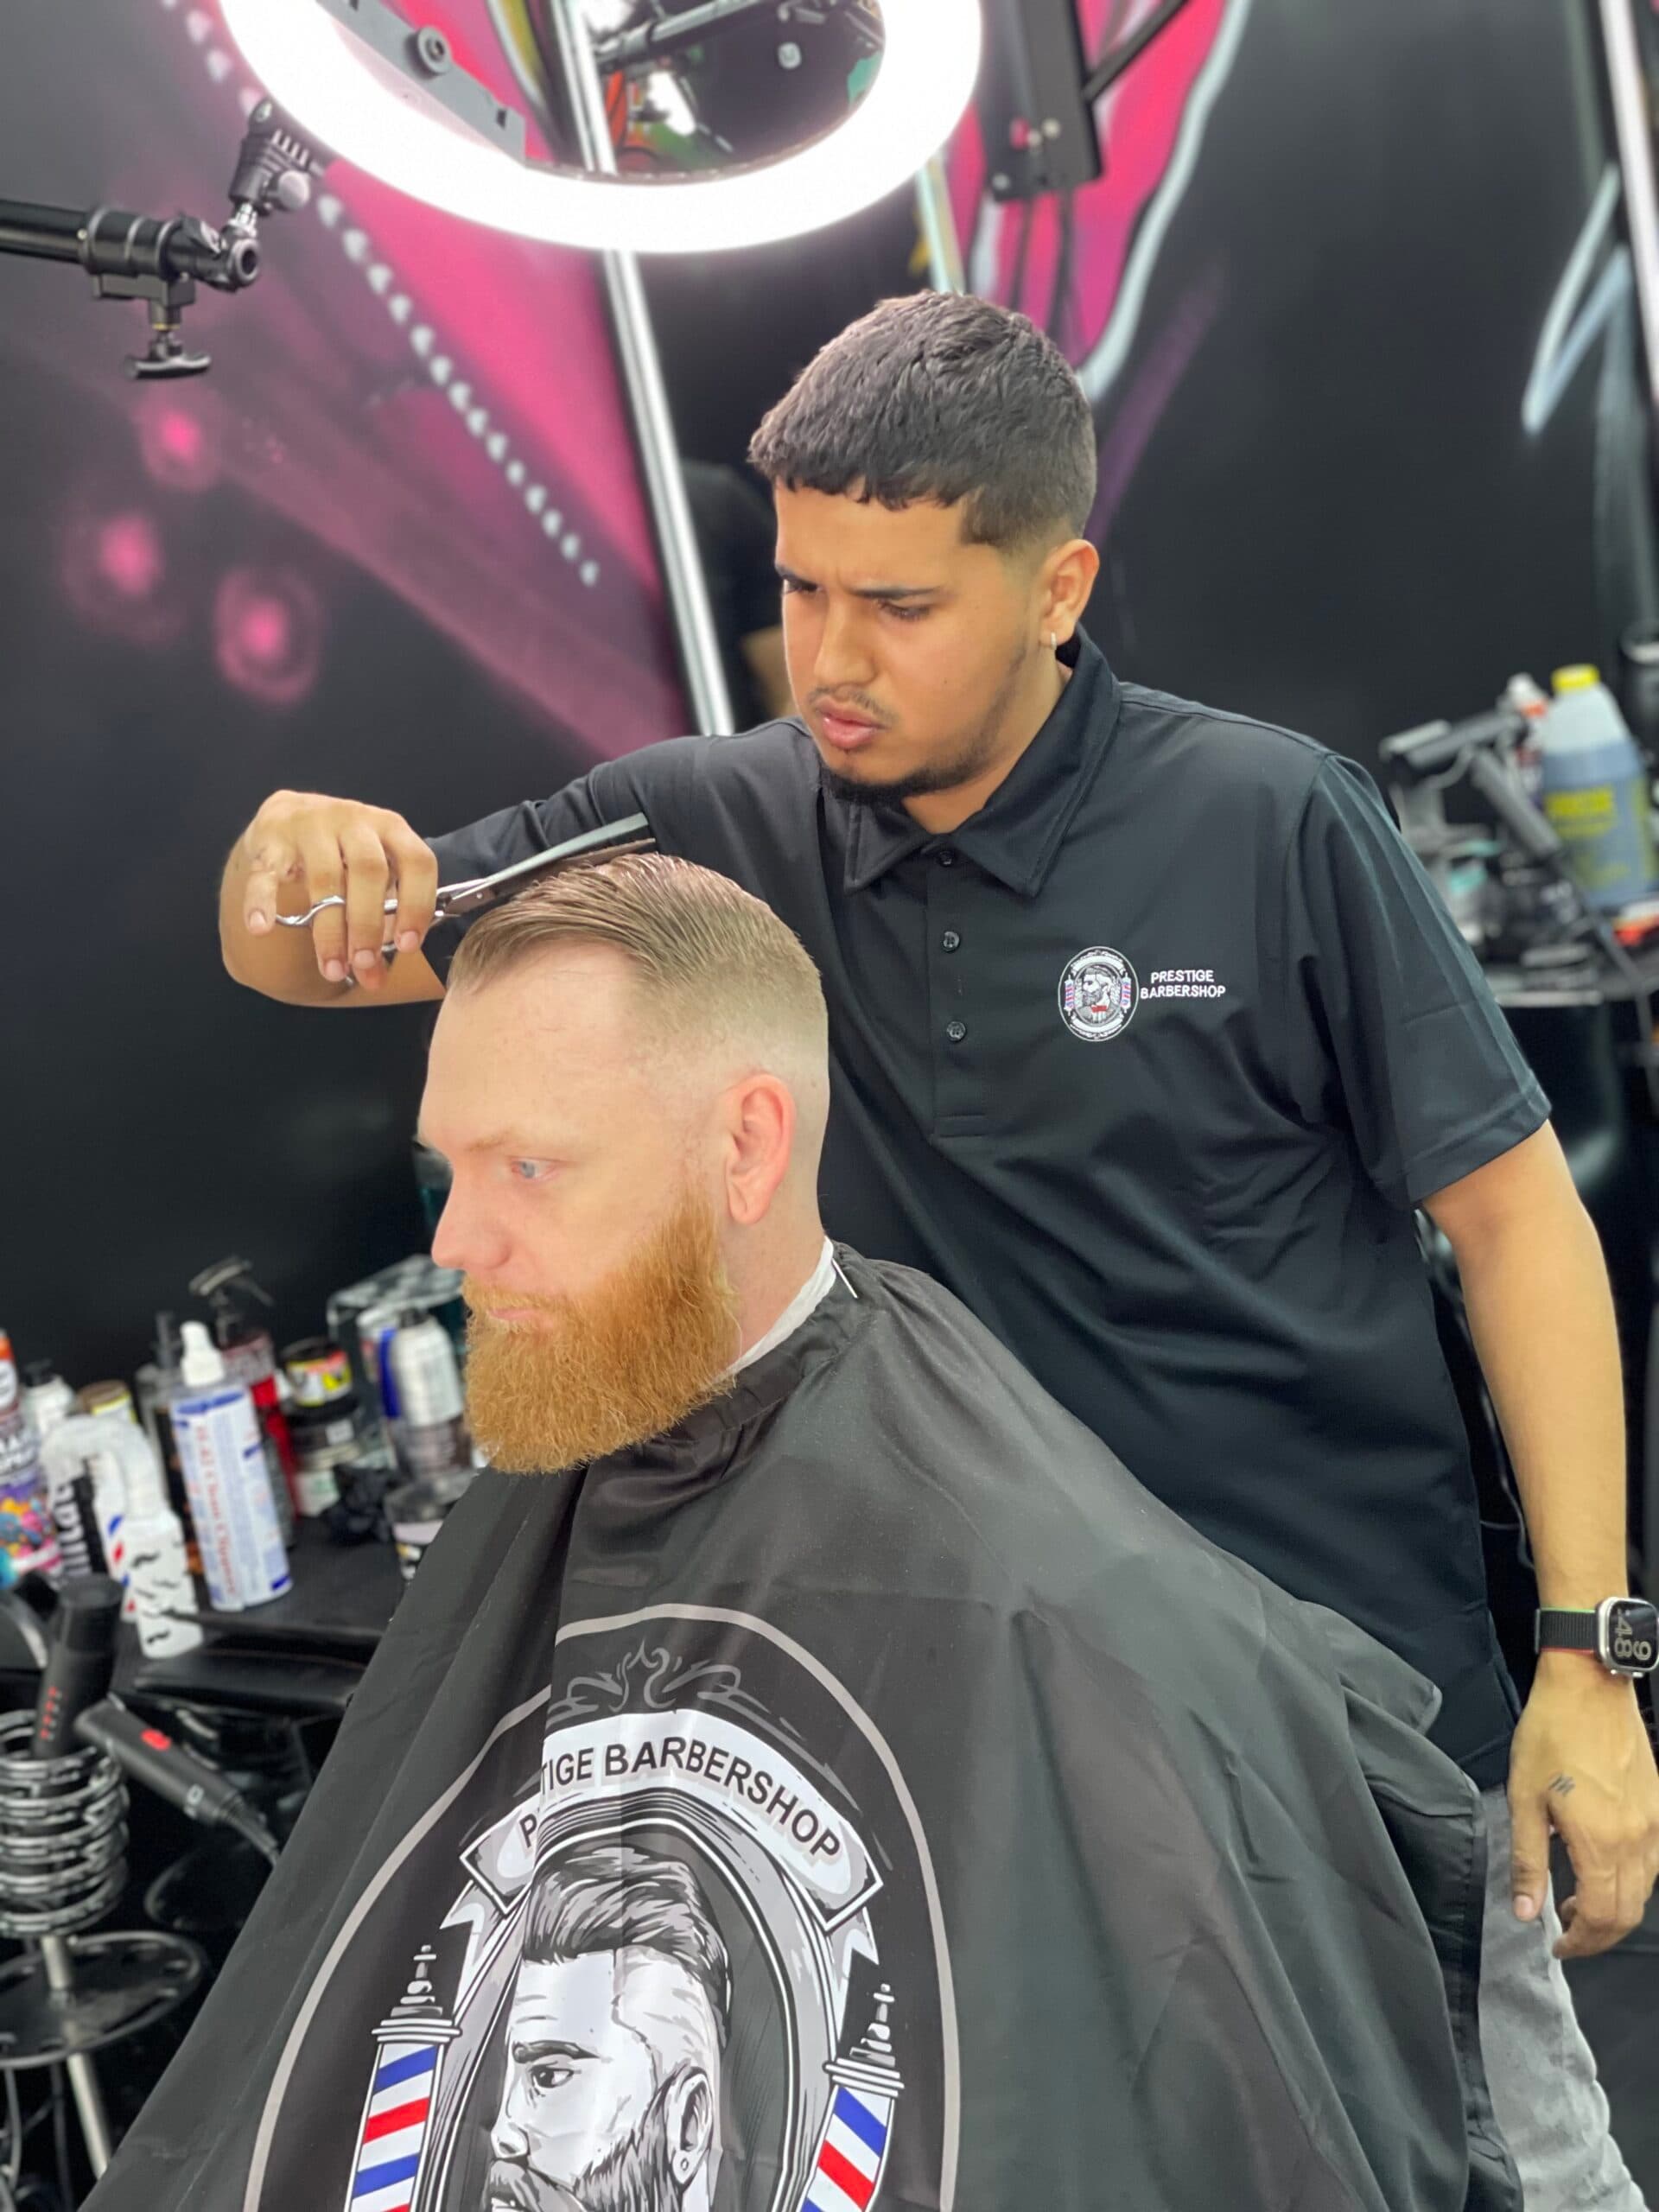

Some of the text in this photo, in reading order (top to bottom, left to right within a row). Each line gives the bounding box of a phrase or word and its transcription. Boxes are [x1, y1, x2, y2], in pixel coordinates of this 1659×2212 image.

[1150, 969, 1214, 983] PRESTIGE
[1140, 985, 1226, 999] BARBERSHOP
[605, 1736, 841, 1859] BARBERSHOP
